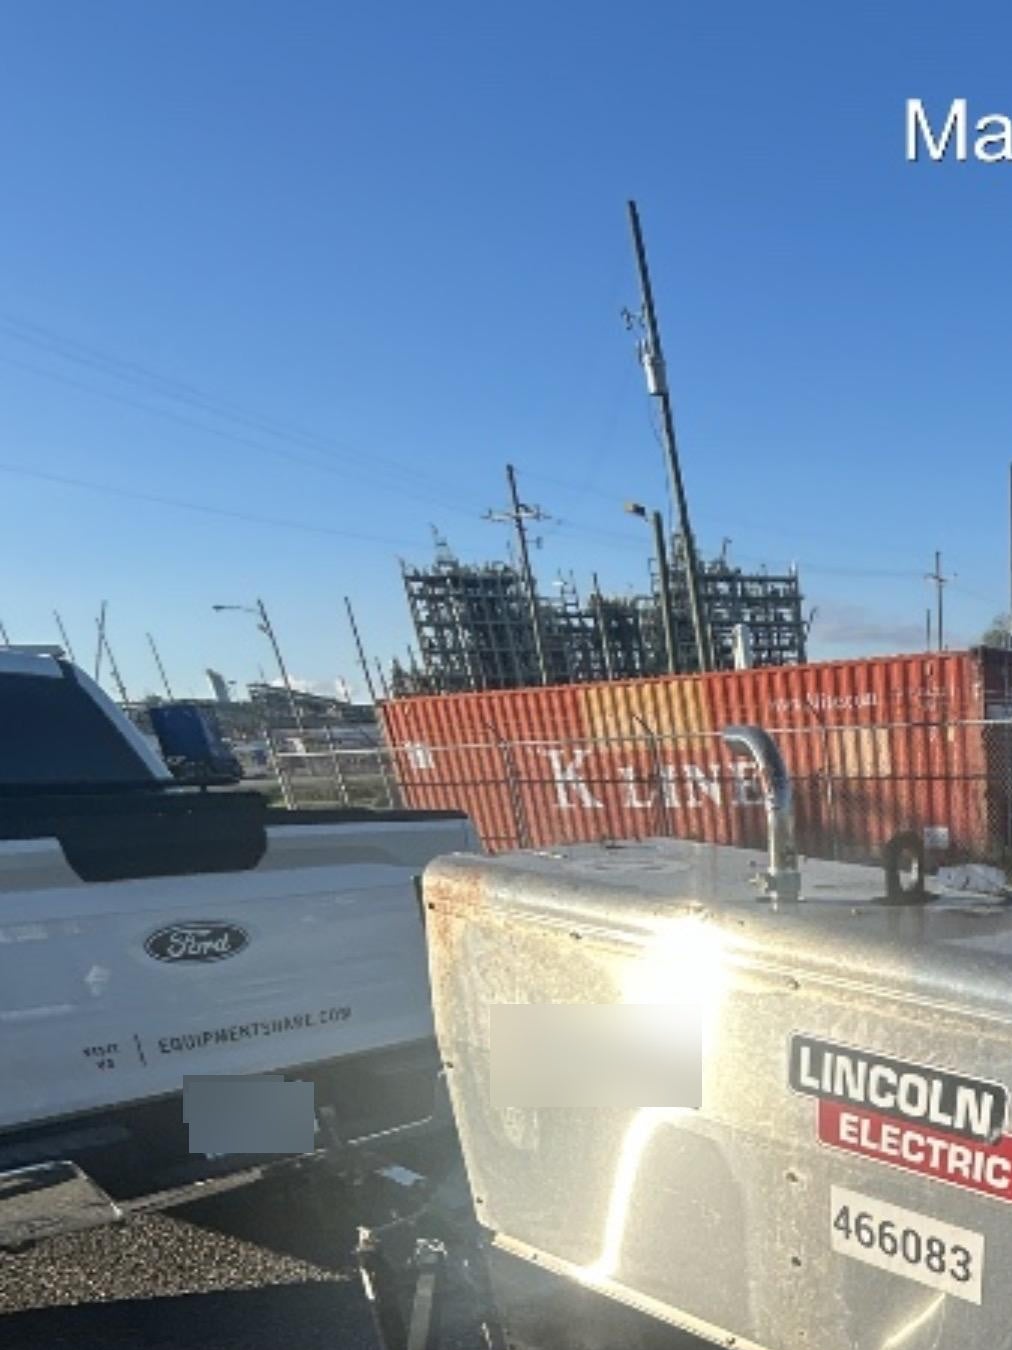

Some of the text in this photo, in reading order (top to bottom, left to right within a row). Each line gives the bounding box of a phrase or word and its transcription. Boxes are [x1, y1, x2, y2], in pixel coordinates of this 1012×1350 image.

[617, 760, 767, 809] LINE
[167, 925, 232, 958] Ford
[800, 1045, 994, 1138] LINCOLN
[838, 1111, 1012, 1190] ELECTRIC
[833, 1204, 972, 1283] 466083
